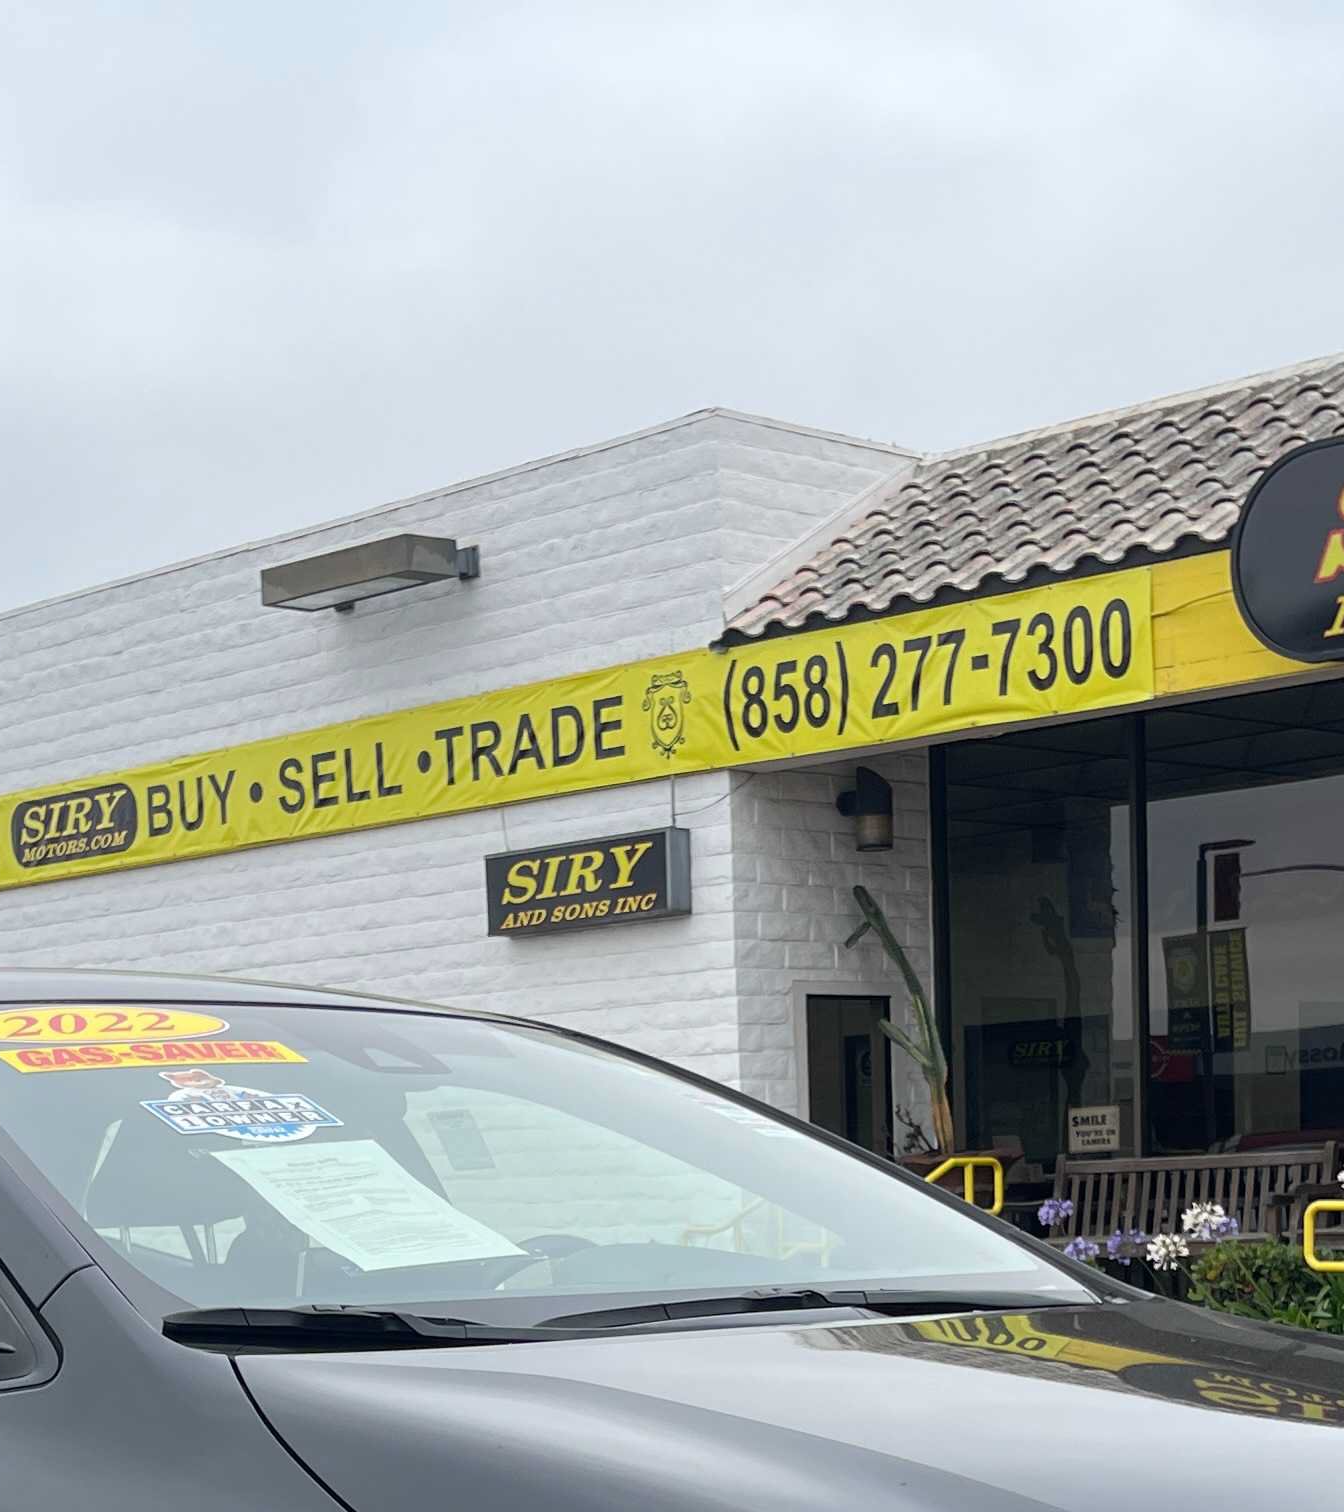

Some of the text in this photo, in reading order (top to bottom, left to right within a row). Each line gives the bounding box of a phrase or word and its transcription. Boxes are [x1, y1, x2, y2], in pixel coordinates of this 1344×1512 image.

[723, 598, 1133, 752] (858) 277-7300
[148, 695, 625, 837] BUY SELL TRADE
[20, 789, 128, 845] SIRY
[22, 829, 127, 864] MOTORS.COM
[501, 841, 652, 906] SIRY
[500, 892, 657, 930] AND SONS INC
[3, 1011, 176, 1039] 2022
[15, 1041, 280, 1069] GAS-SAVER
[162, 1098, 310, 1116] CARFAX
[208, 1111, 325, 1127] OWNER
[1071, 1114, 1107, 1127] SMILE
